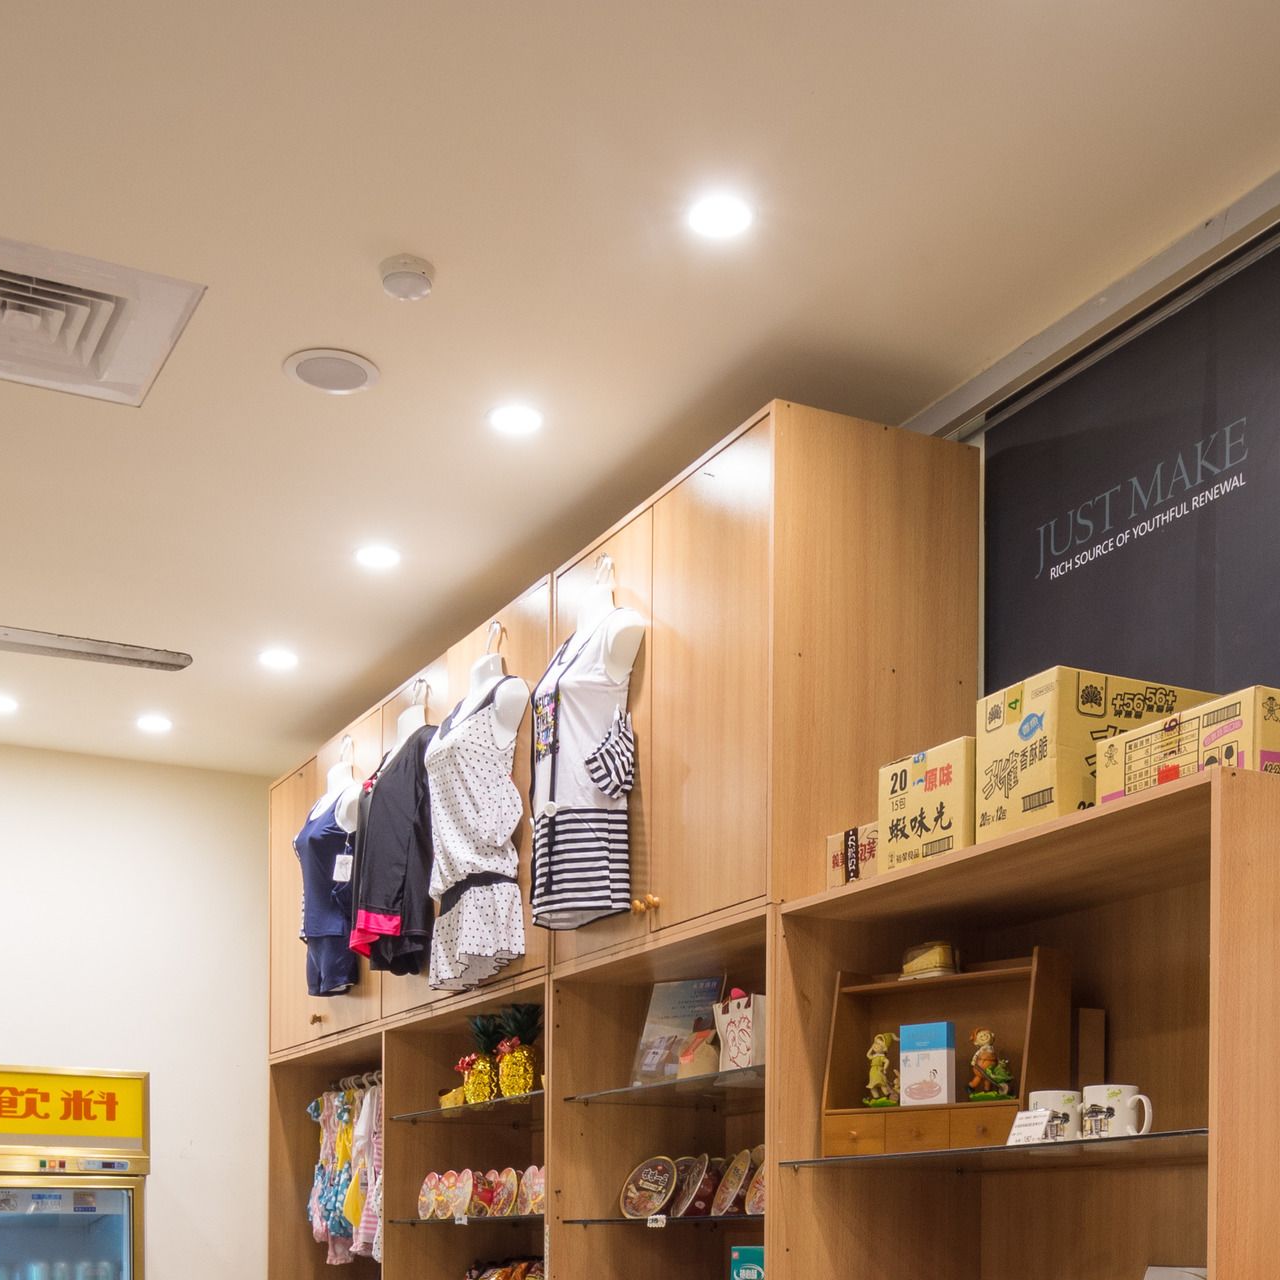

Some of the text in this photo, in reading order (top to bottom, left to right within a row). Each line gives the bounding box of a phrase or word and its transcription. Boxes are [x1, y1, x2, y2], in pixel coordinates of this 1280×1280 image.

[1034, 416, 1249, 579] JUST MAKE
[1050, 472, 1247, 580] RICH SOURCE OF YOUTHFUL RENEWAL
[890, 768, 908, 795] 20
[924, 763, 953, 792] 原味
